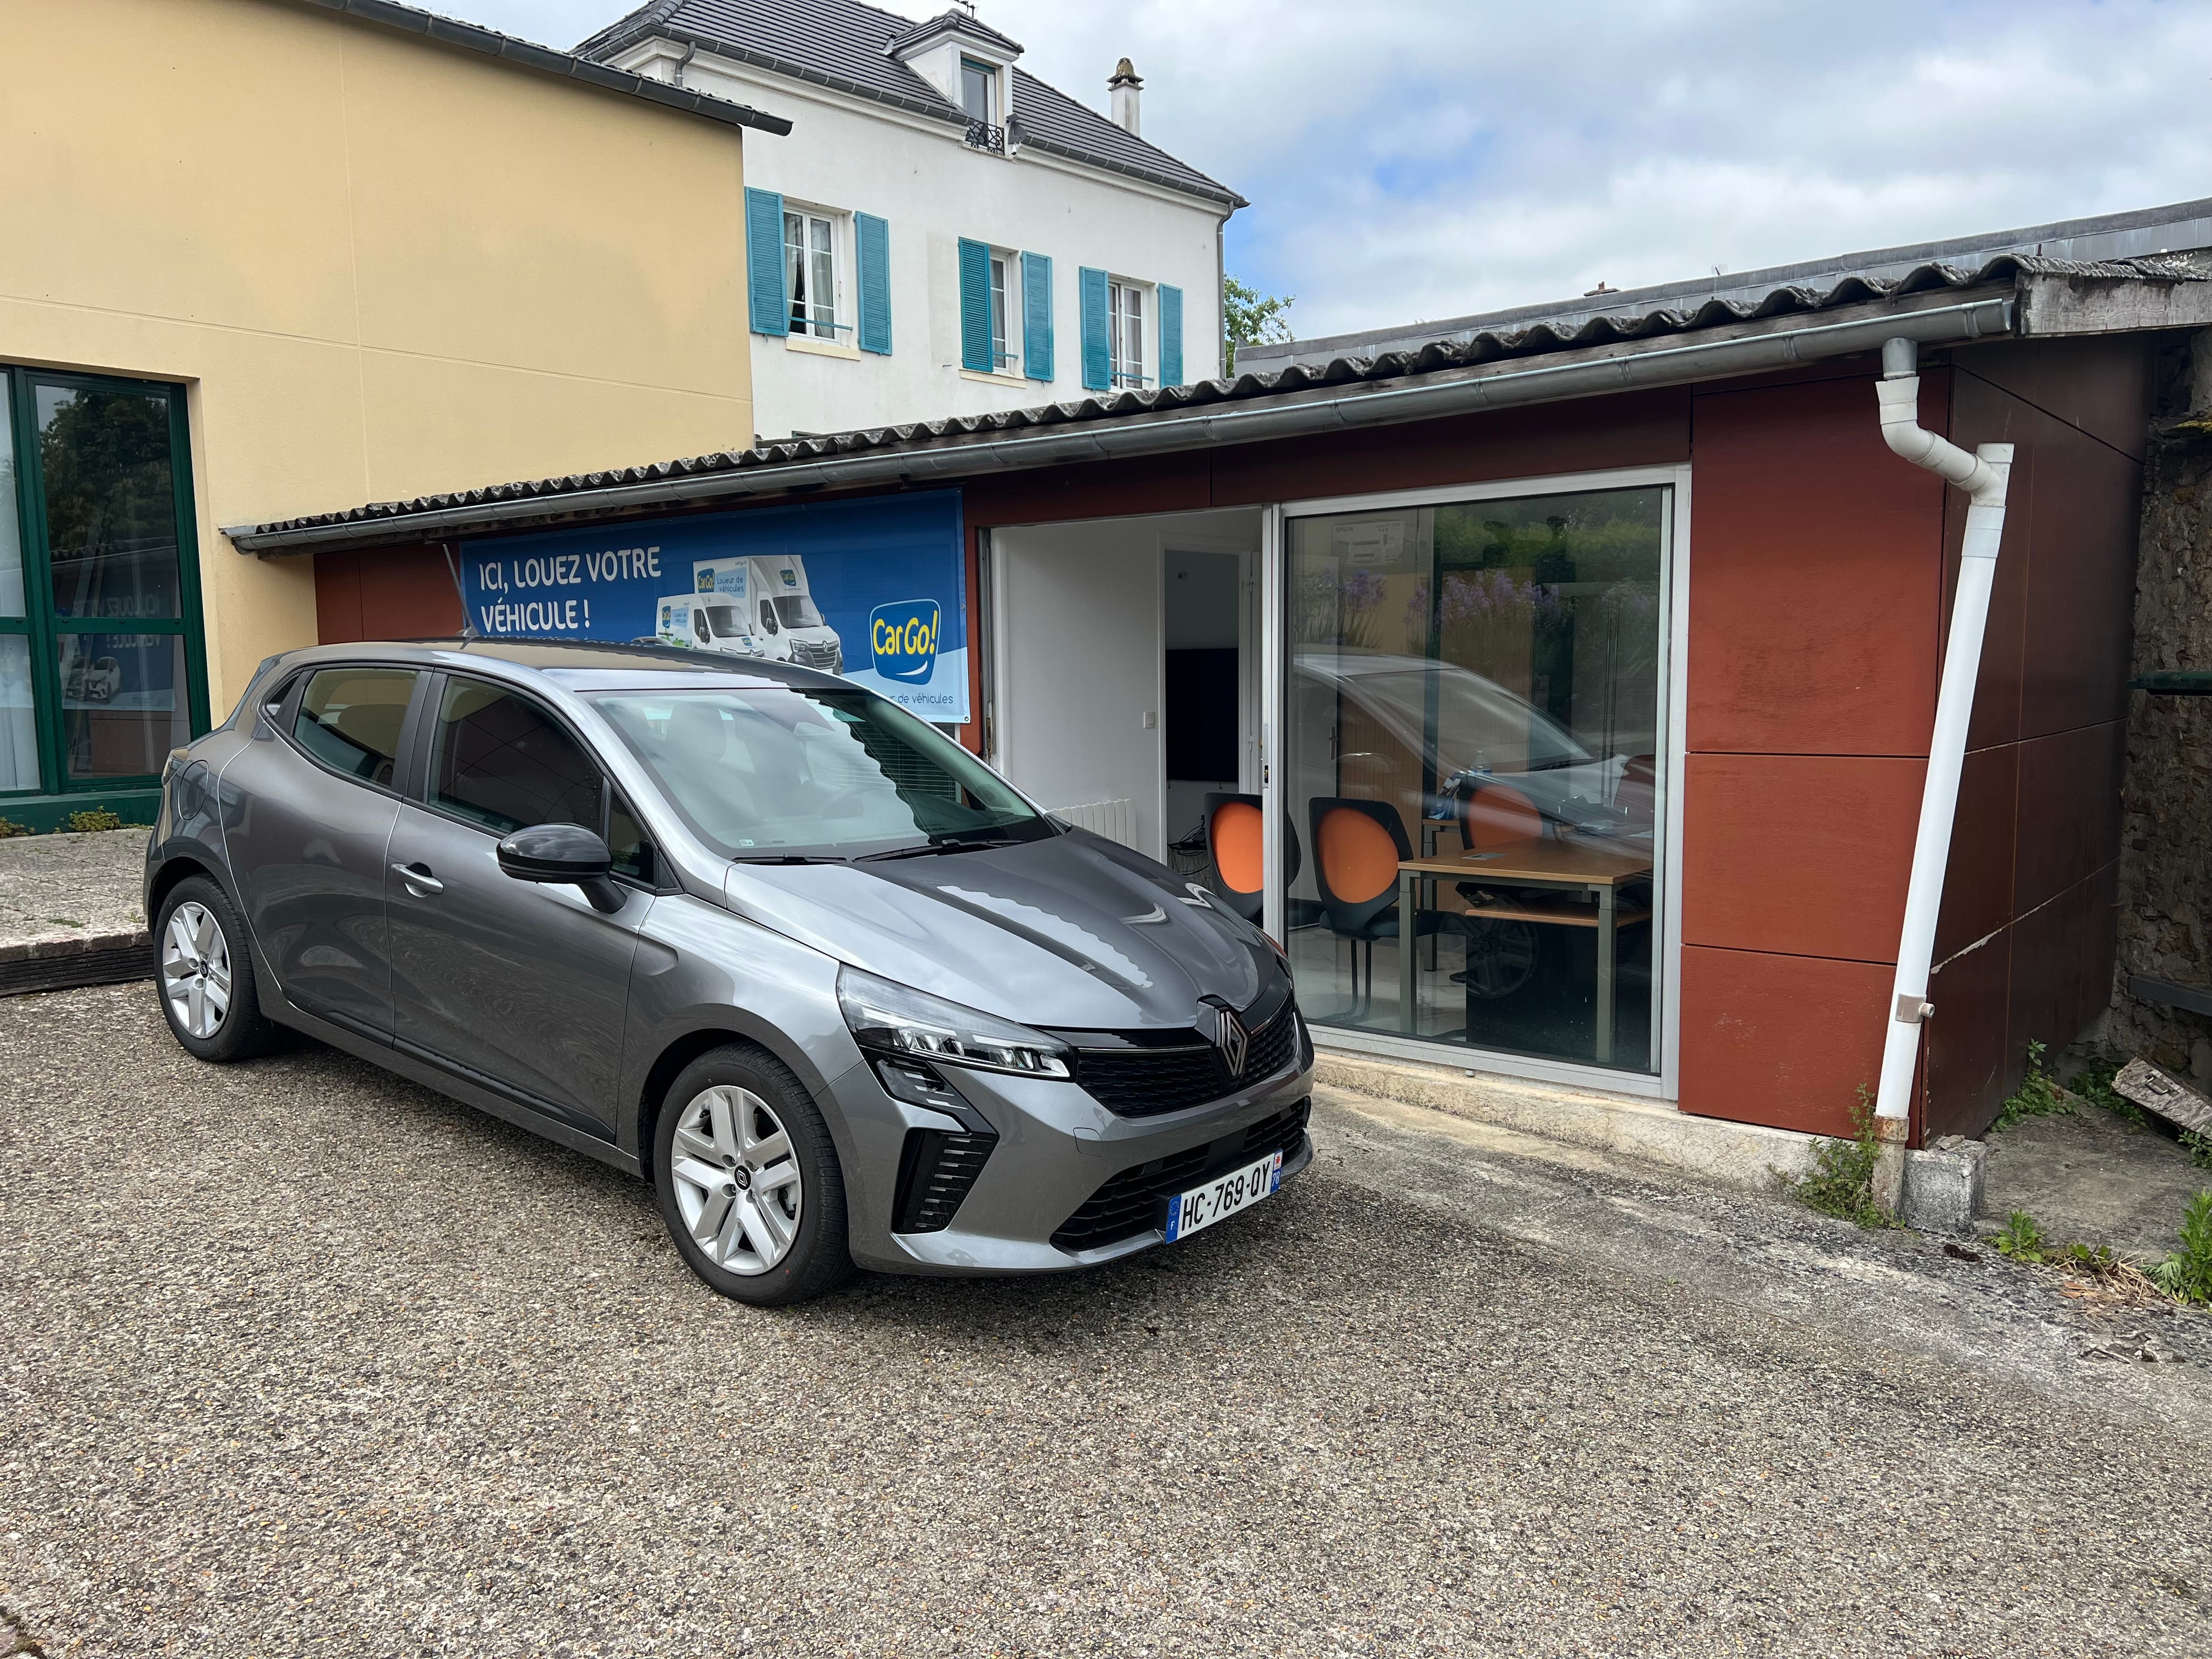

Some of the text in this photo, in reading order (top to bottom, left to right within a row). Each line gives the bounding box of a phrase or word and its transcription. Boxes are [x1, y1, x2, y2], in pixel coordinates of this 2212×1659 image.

[479, 546, 661, 594] ICI, LOUEZ VOTRE
[736, 575, 743, 584] de
[481, 596, 590, 633] VÉHICULE !
[873, 610, 938, 655] CarGo!
[898, 693, 909, 703] de
[912, 693, 953, 704] véhicules
[1272, 1171, 1280, 1186] 78
[1170, 1220, 1175, 1231] F
